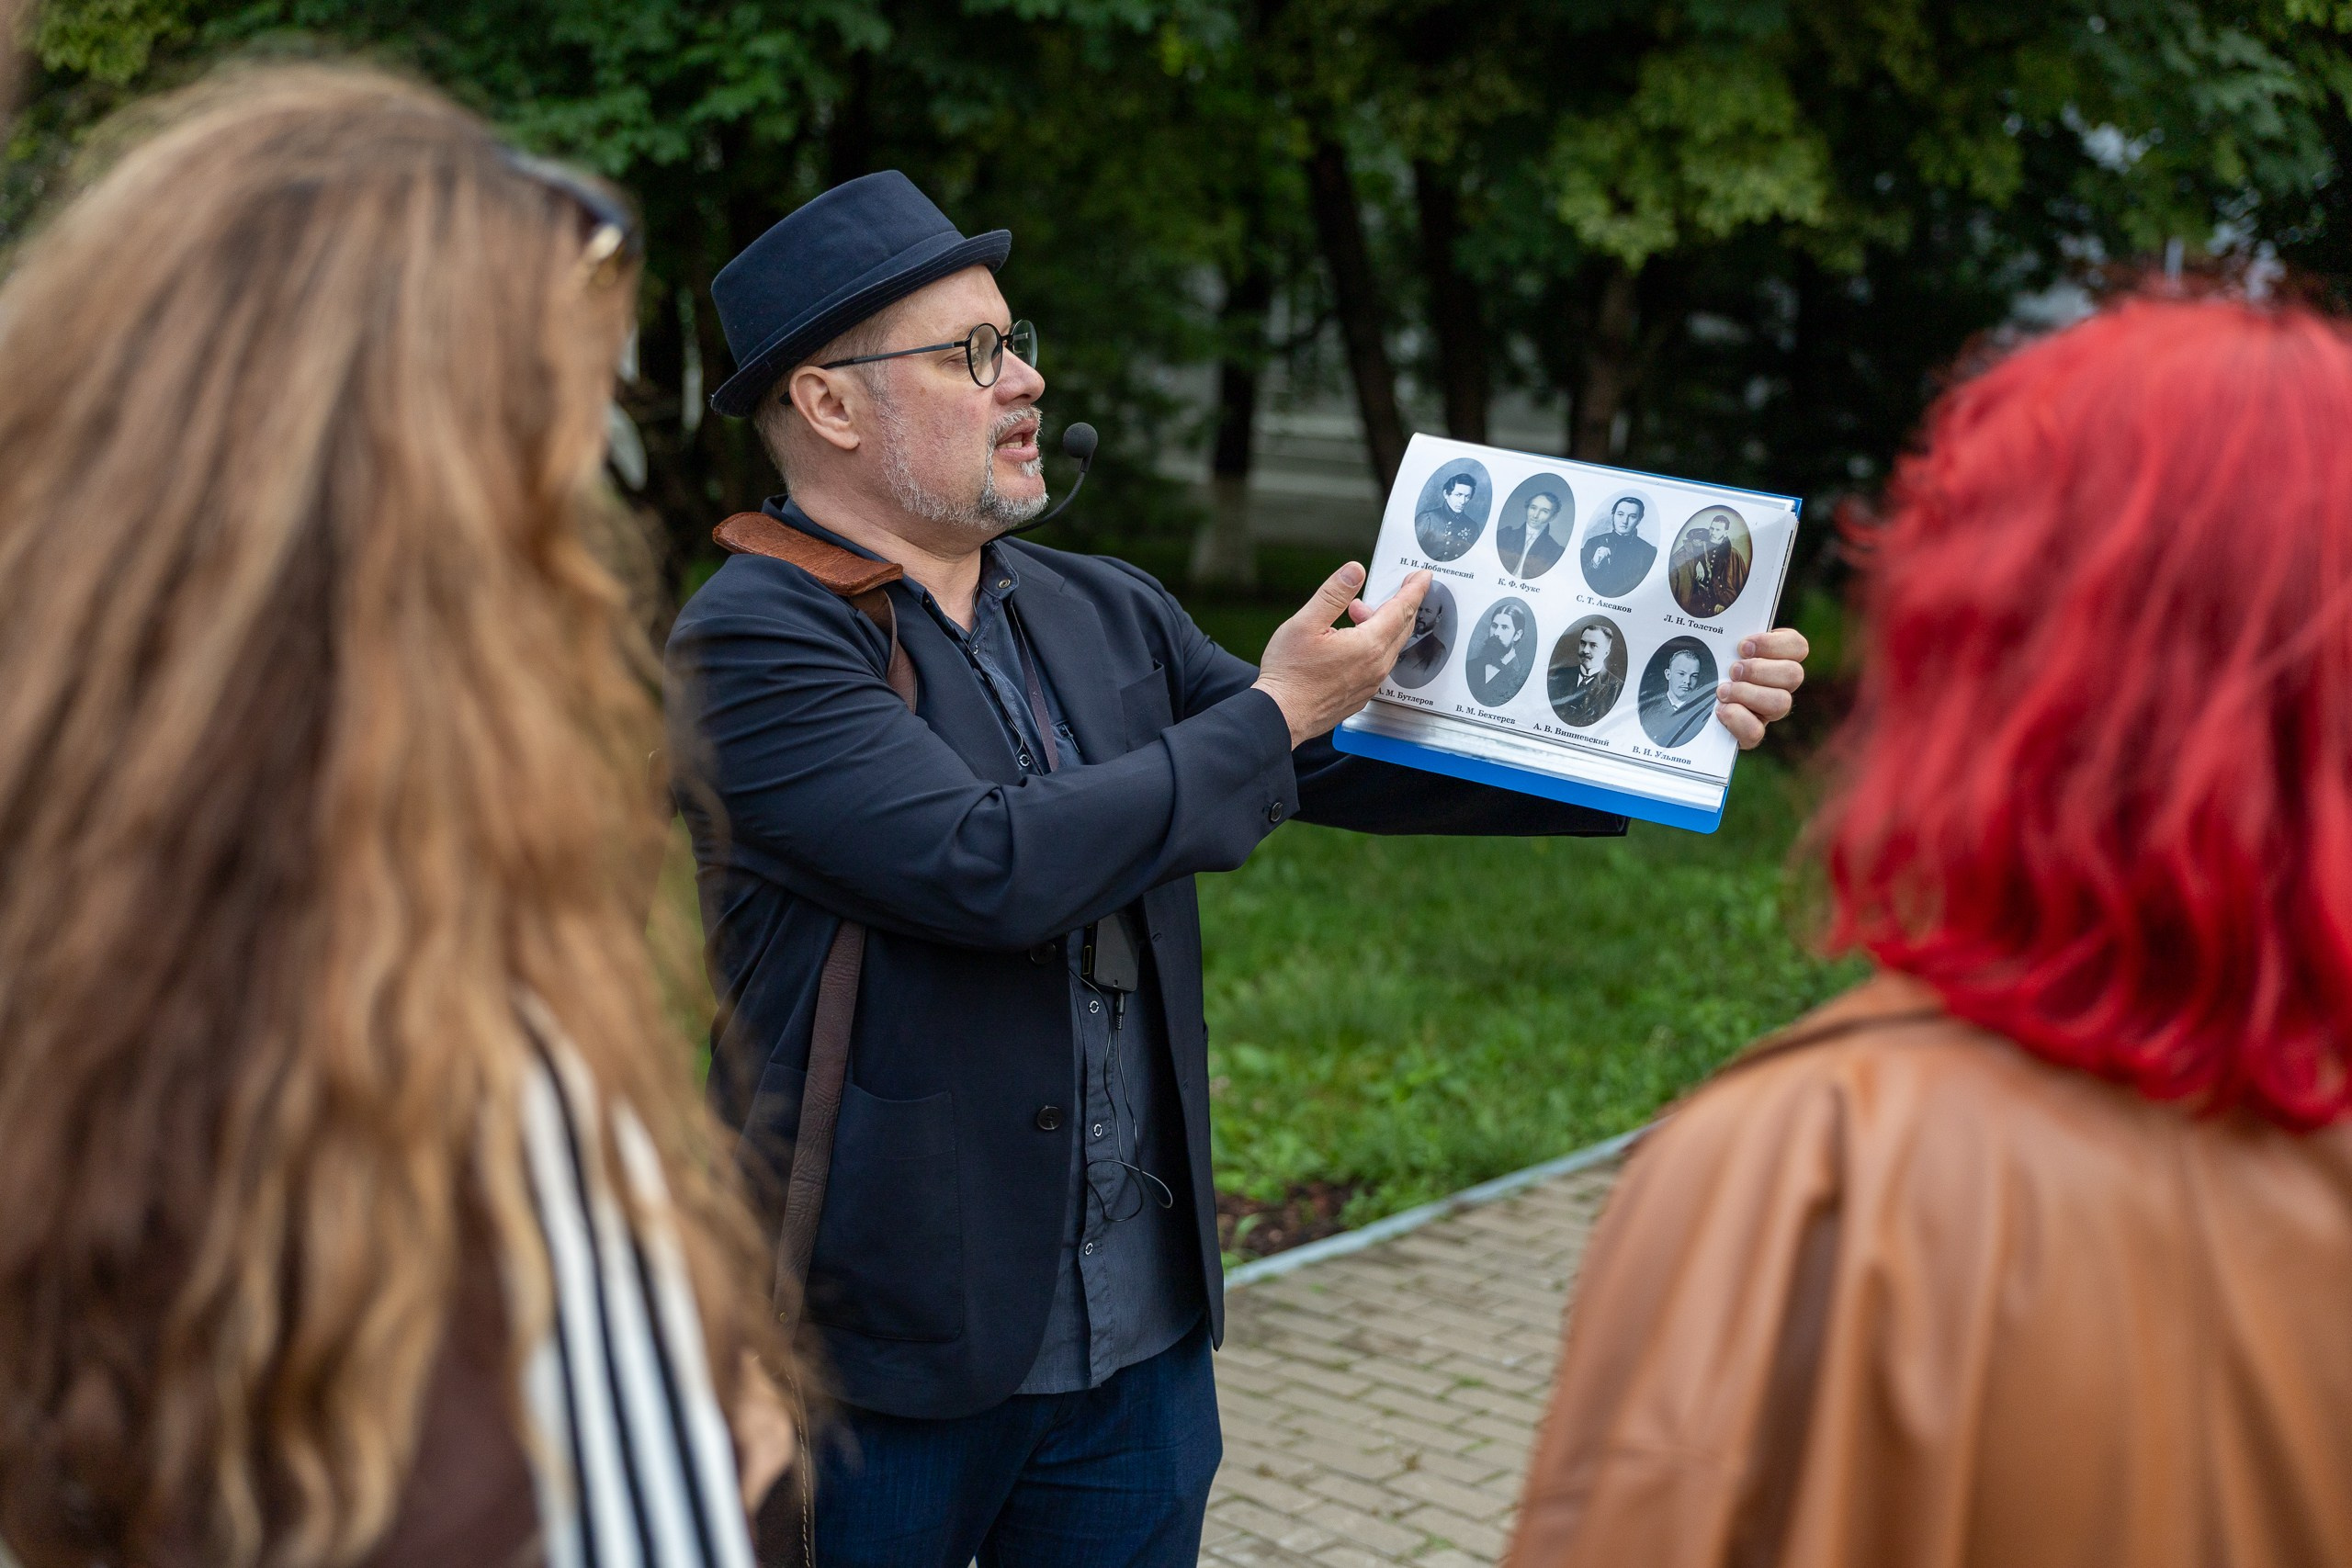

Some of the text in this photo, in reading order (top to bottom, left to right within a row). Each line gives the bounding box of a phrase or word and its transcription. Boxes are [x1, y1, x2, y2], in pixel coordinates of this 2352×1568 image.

[1399, 558, 1475, 580] Н. И. Лобачевский
[1498, 578, 1506, 586] К.
[1520, 582, 1541, 592] Фукс
[1576, 594, 1633, 614] С. Т. Аксаков
[1663, 614, 1724, 634] Л. Н. Толстой
[1377, 687, 1434, 705] А. М. Бутлеров
[1455, 705, 1516, 724] В. М. Бехтерев
[1544, 725, 1553, 733] В.
[1555, 727, 1610, 746] Вишневский
[1632, 745, 1691, 765] В. И. Ульянов
